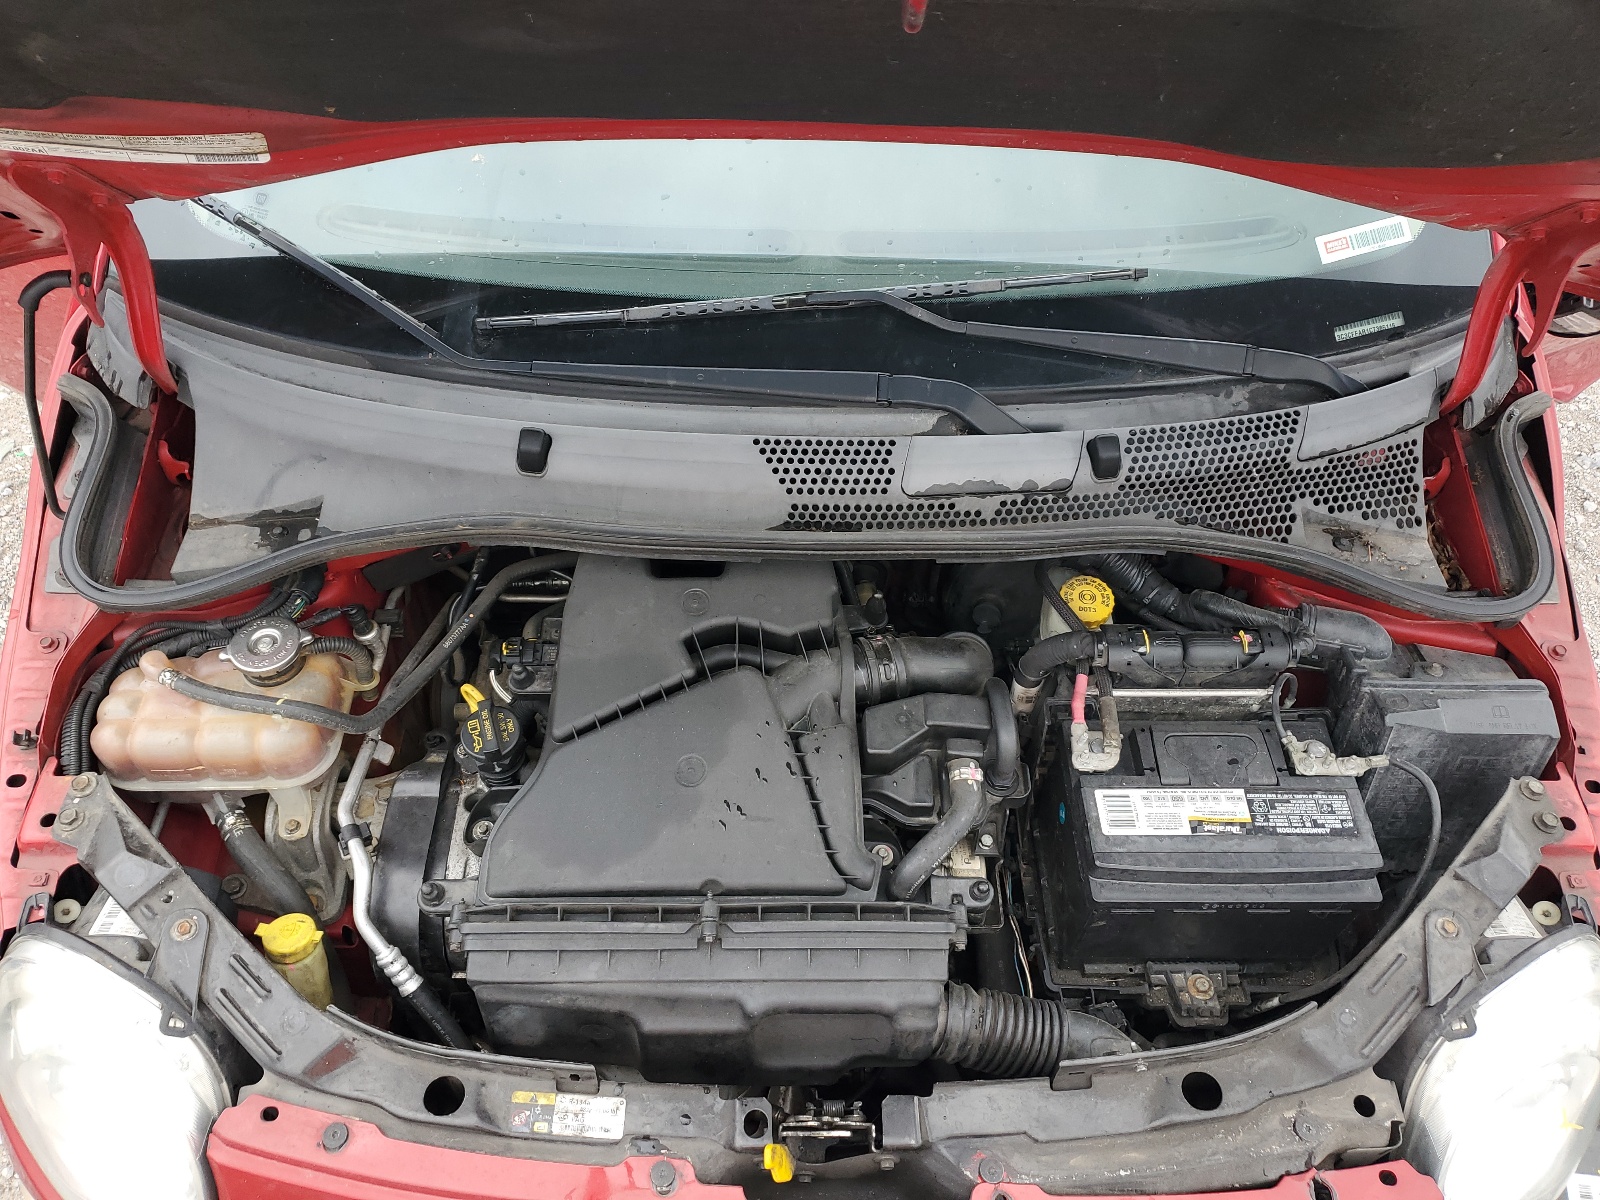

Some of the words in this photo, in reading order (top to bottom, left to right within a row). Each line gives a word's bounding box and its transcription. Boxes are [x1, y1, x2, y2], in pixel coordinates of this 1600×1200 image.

[480, 708, 488, 720] OIL
[483, 718, 494, 742] ENGINE
[506, 718, 515, 733] ONLY
[1202, 824, 1242, 834] Duralast
